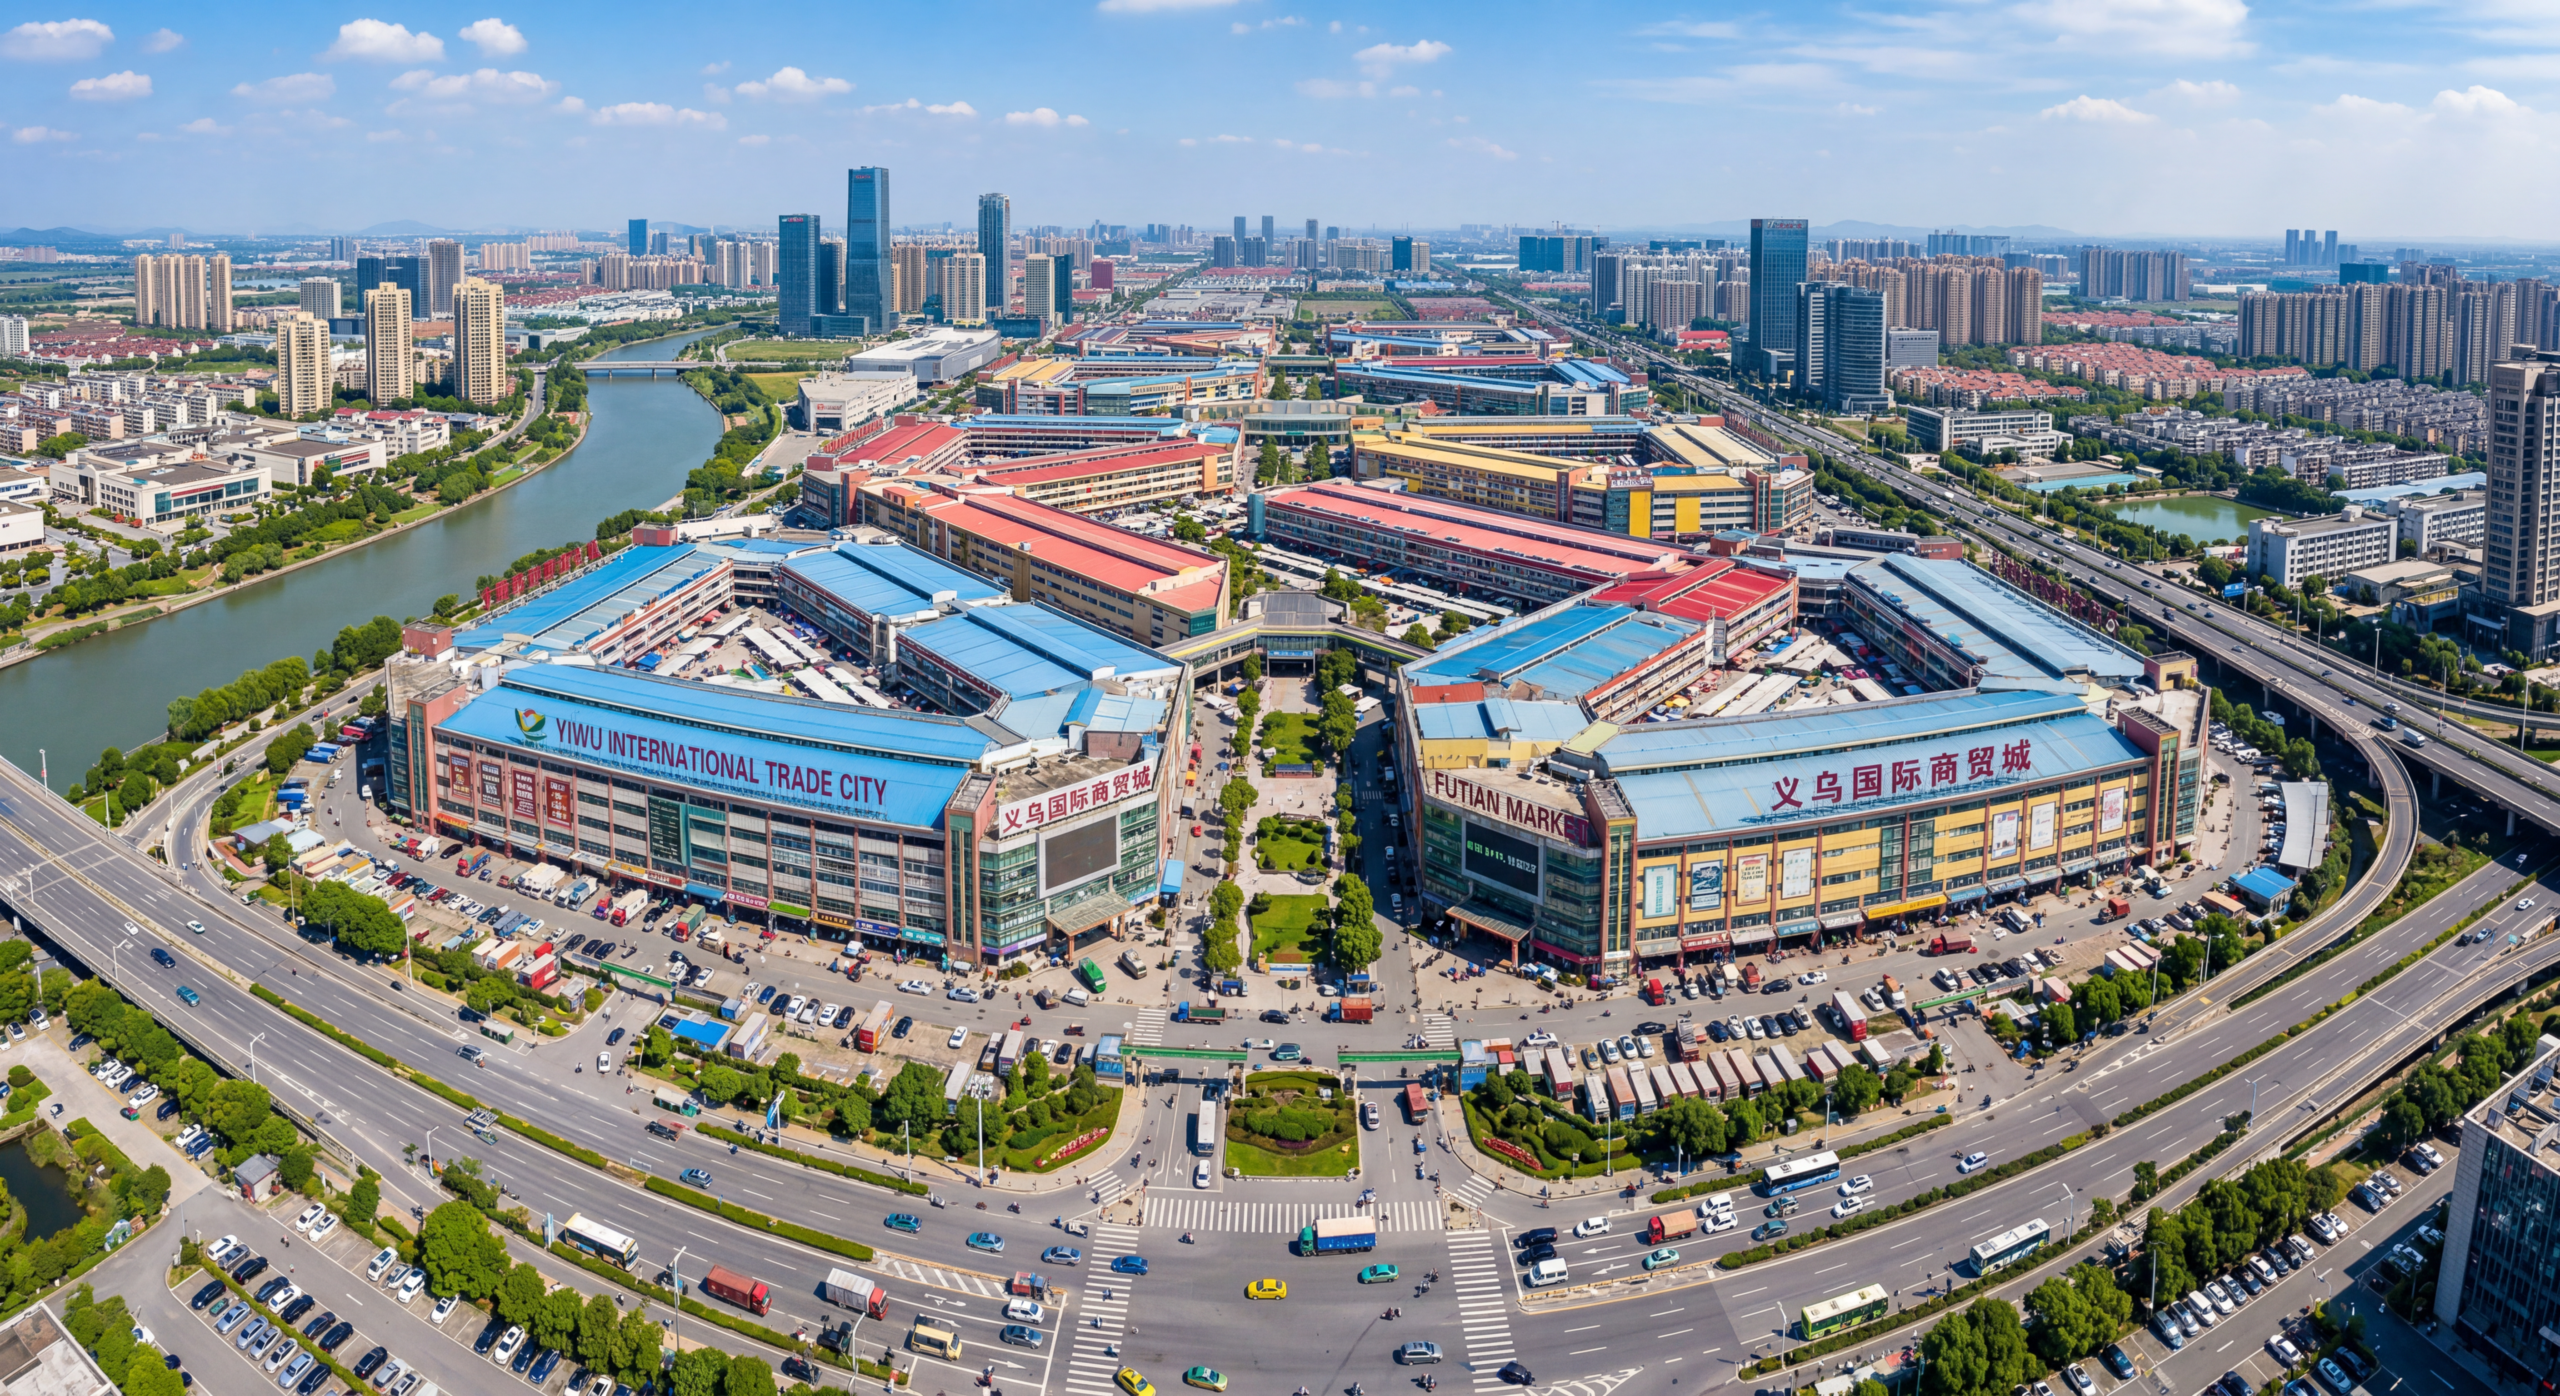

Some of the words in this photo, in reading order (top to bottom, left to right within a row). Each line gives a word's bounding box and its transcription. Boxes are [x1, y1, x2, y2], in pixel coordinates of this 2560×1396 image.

[556, 717, 603, 752] YIWU
[608, 730, 760, 785] INTERNATIONAL
[765, 760, 833, 797] TRADE
[839, 772, 888, 806] CITY
[1435, 771, 1500, 815] FUTIAN
[1772, 738, 2031, 811] 义乌国际商贸城
[1002, 765, 1151, 834] 义乌国际商贸城
